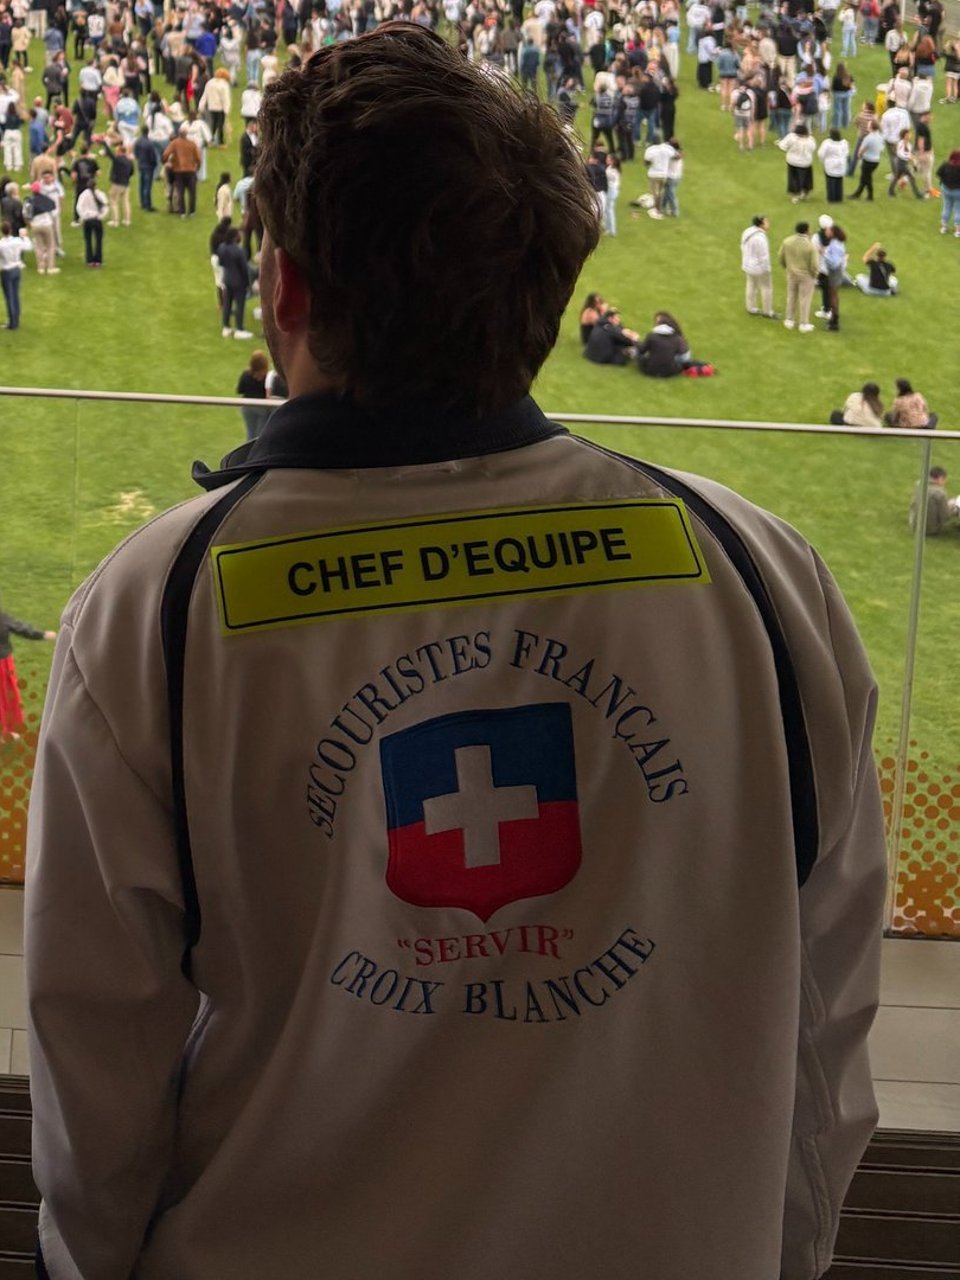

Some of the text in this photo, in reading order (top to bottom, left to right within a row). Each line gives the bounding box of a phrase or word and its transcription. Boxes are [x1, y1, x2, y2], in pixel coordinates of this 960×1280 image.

[288, 528, 632, 596] CHEF D'EQUIPE
[306, 629, 689, 838] SECOURISTES FRANÇAIS
[329, 927, 656, 1023] CROIX BLANCHE
[397, 924, 574, 967] "SERVIR"
